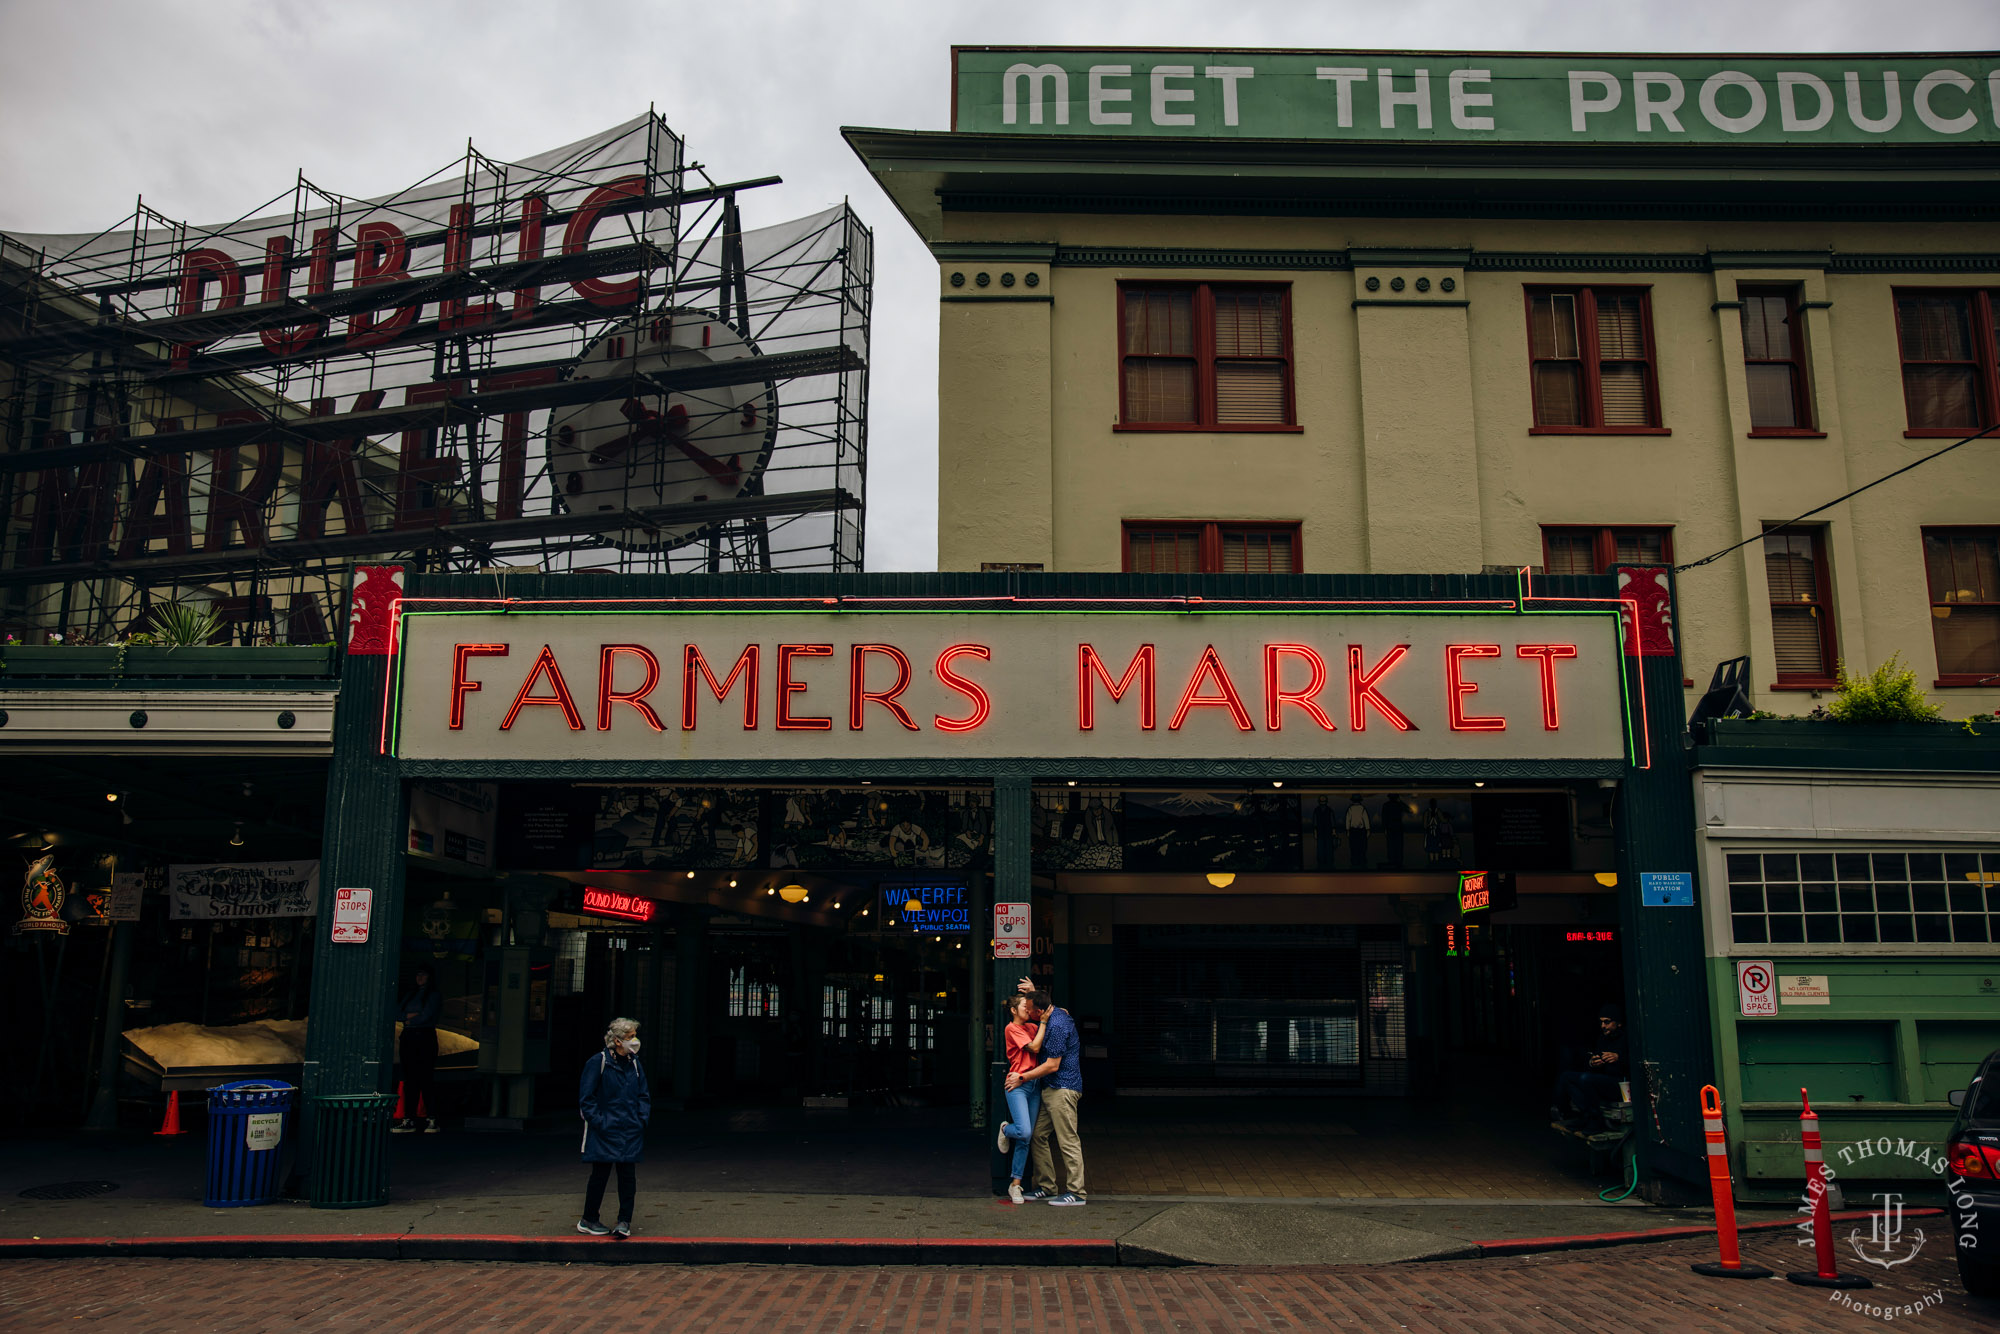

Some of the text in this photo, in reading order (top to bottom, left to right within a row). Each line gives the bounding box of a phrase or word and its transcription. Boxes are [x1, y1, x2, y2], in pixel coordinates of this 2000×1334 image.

[1002, 63, 1255, 127] MEET
[1315, 67, 1496, 131] THE
[170, 174, 648, 372] PUBLIC
[448, 642, 1578, 732] FARMERS MARKET
[268, 866, 296, 877] Fresh
[1464, 876, 1484, 892] ROTARY
[339, 890, 350, 899] NO
[1462, 890, 1490, 910] GROCERY
[208, 899, 278, 917] Salmon
[340, 901, 367, 911] STOPS
[996, 905, 1007, 914] NO
[40, 921, 65, 930] FAMOUS
[999, 916, 1026, 926] STOPS
[1748, 995, 1769, 1003] THIS
[1746, 1002, 1773, 1011] SPACE
